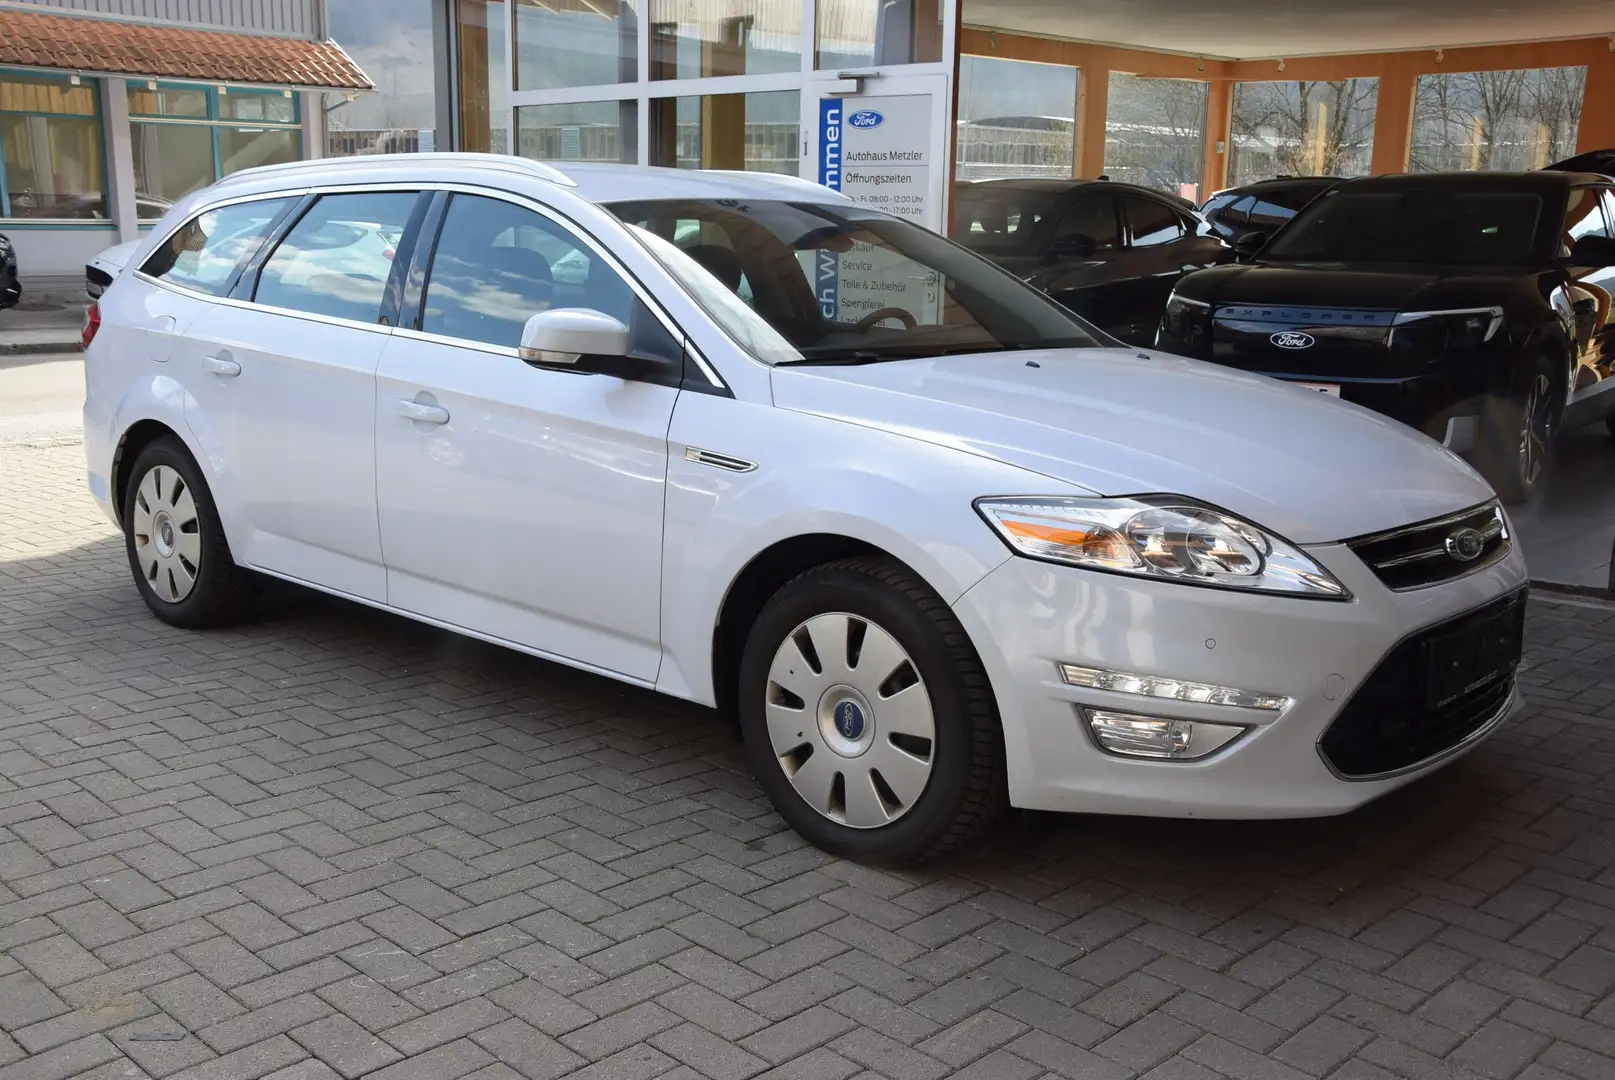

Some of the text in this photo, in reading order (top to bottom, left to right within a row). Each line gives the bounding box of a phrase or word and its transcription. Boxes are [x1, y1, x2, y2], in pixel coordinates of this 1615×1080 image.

[854, 112, 877, 126] Ford
[825, 109, 839, 188] mmen
[846, 150, 923, 161] Autohaus Metzler
[845, 172, 912, 185] Öffnungszeiten
[860, 195, 869, 203] Fr.
[869, 195, 889, 203] 08:00
[893, 195, 911, 203] 12:00
[911, 195, 924, 203] Uhr
[893, 206, 911, 215] 17:00
[911, 206, 924, 215] Uhr
[842, 261, 873, 271] Service
[842, 279, 907, 292] Teile & Zubehör
[841, 298, 885, 310] Spenglerei
[1225, 308, 1376, 321] EXPLORER
[1277, 333, 1306, 347] Ford
